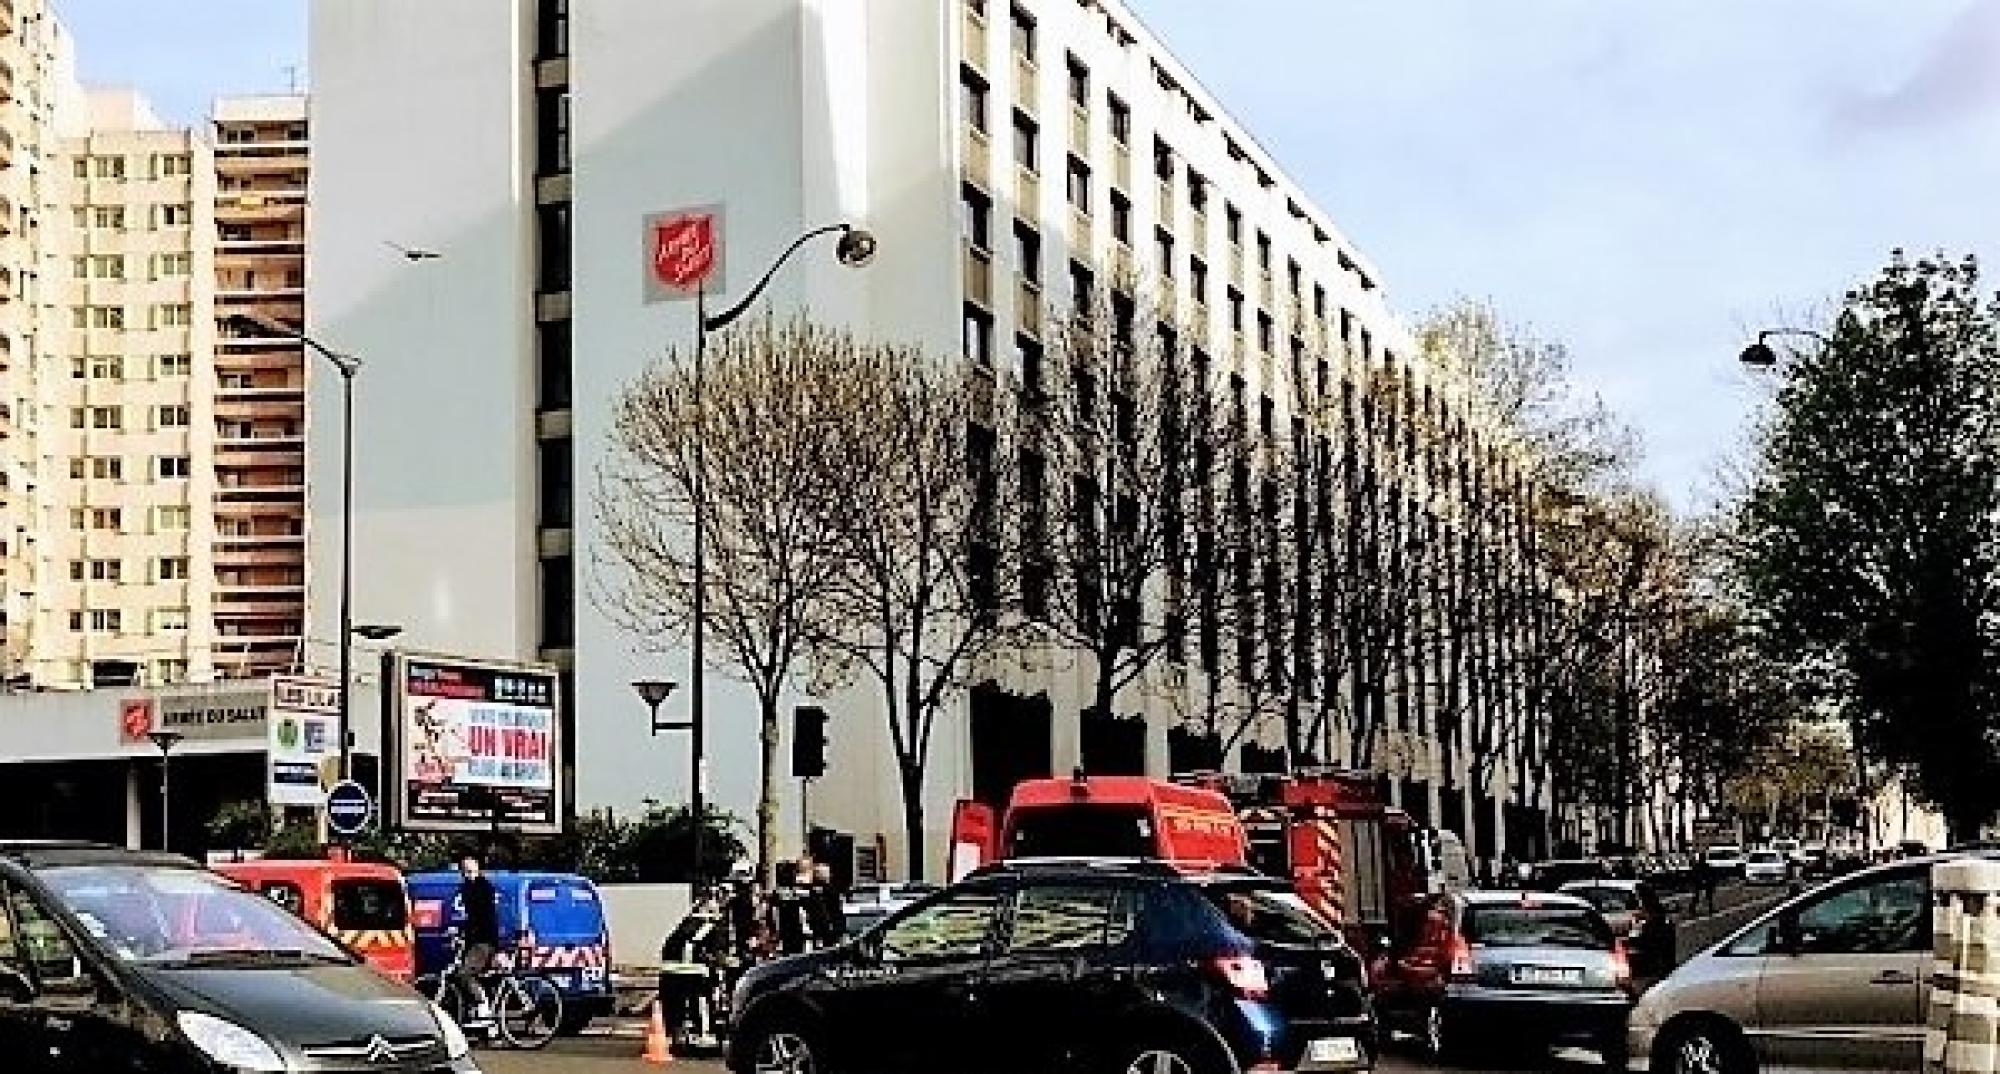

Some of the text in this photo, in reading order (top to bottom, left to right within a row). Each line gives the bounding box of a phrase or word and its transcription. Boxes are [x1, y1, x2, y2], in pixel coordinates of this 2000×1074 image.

[206, 708, 225, 724] DU
[227, 705, 267, 723] SALUT
[469, 726, 547, 760] UN VRAI
